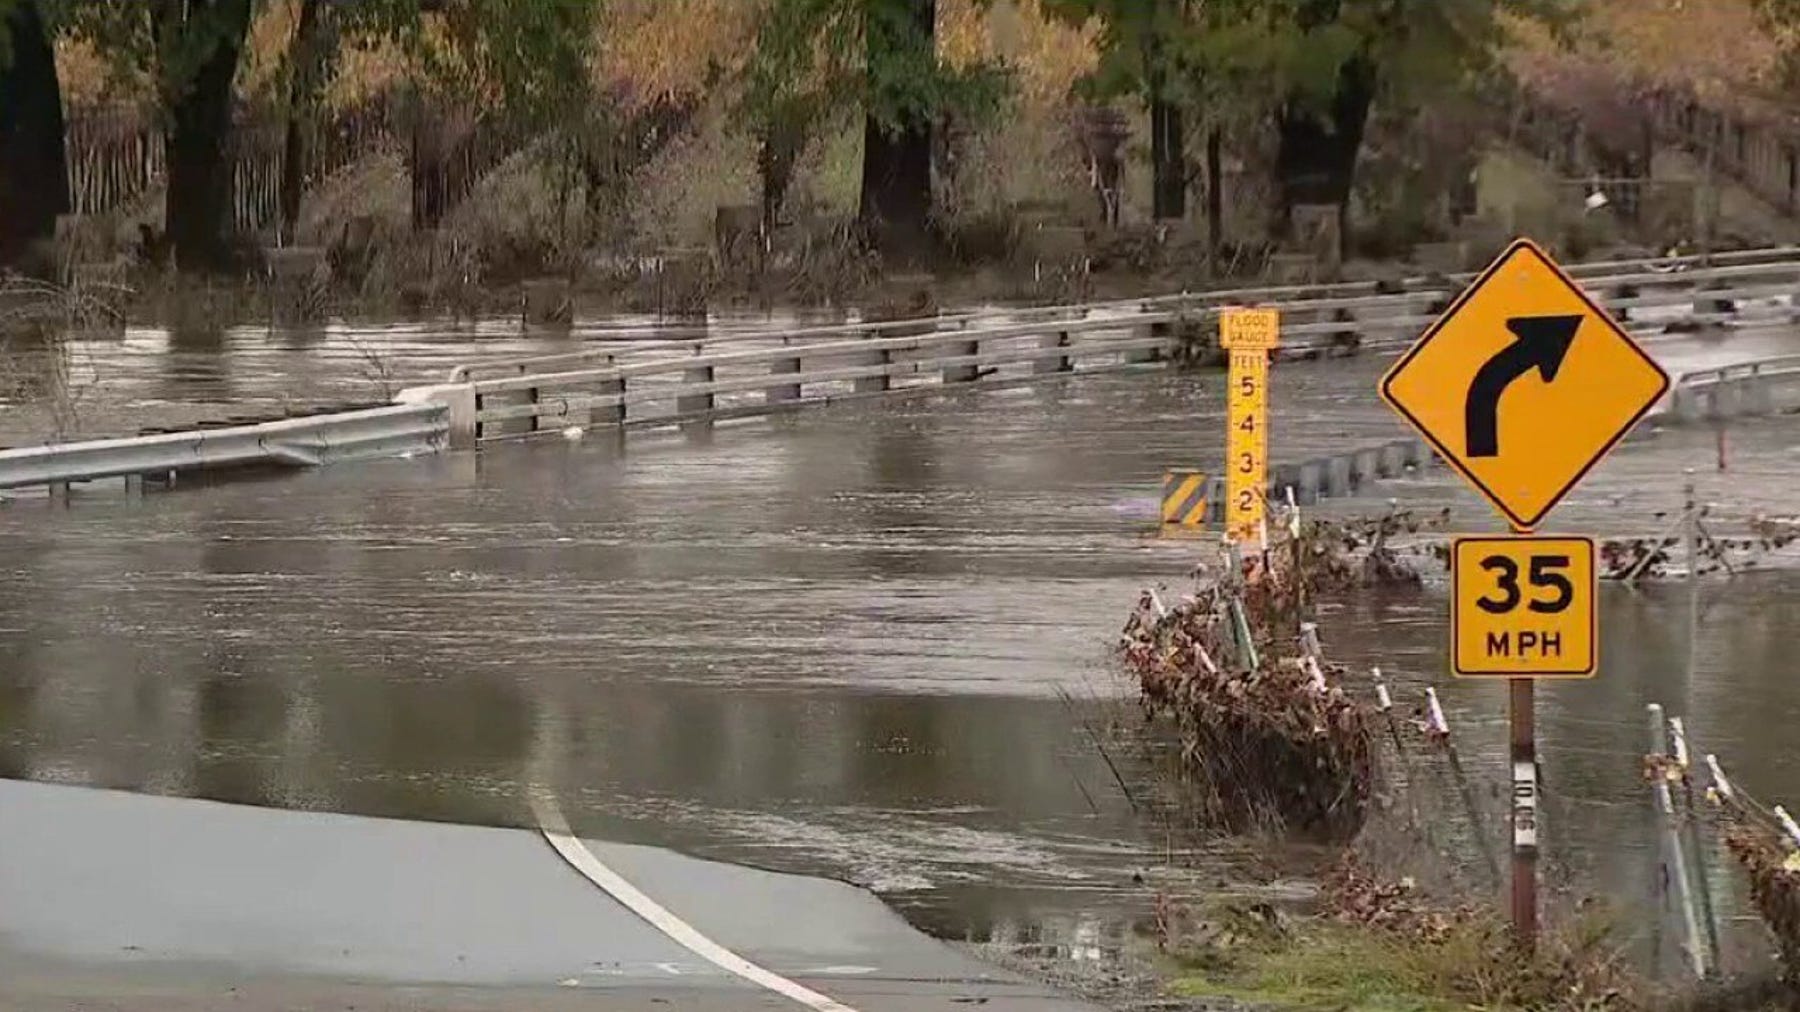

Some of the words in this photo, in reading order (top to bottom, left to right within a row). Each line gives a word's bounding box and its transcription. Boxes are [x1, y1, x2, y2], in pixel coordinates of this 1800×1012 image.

[1234, 355, 1262, 368] FEET
[1241, 376, 1254, 397] 5
[1240, 414, 1254, 434] 4
[1240, 453, 1252, 473] 3
[1239, 491, 1252, 511] 2
[1476, 555, 1573, 614] 35
[1487, 631, 1561, 657] MPH
